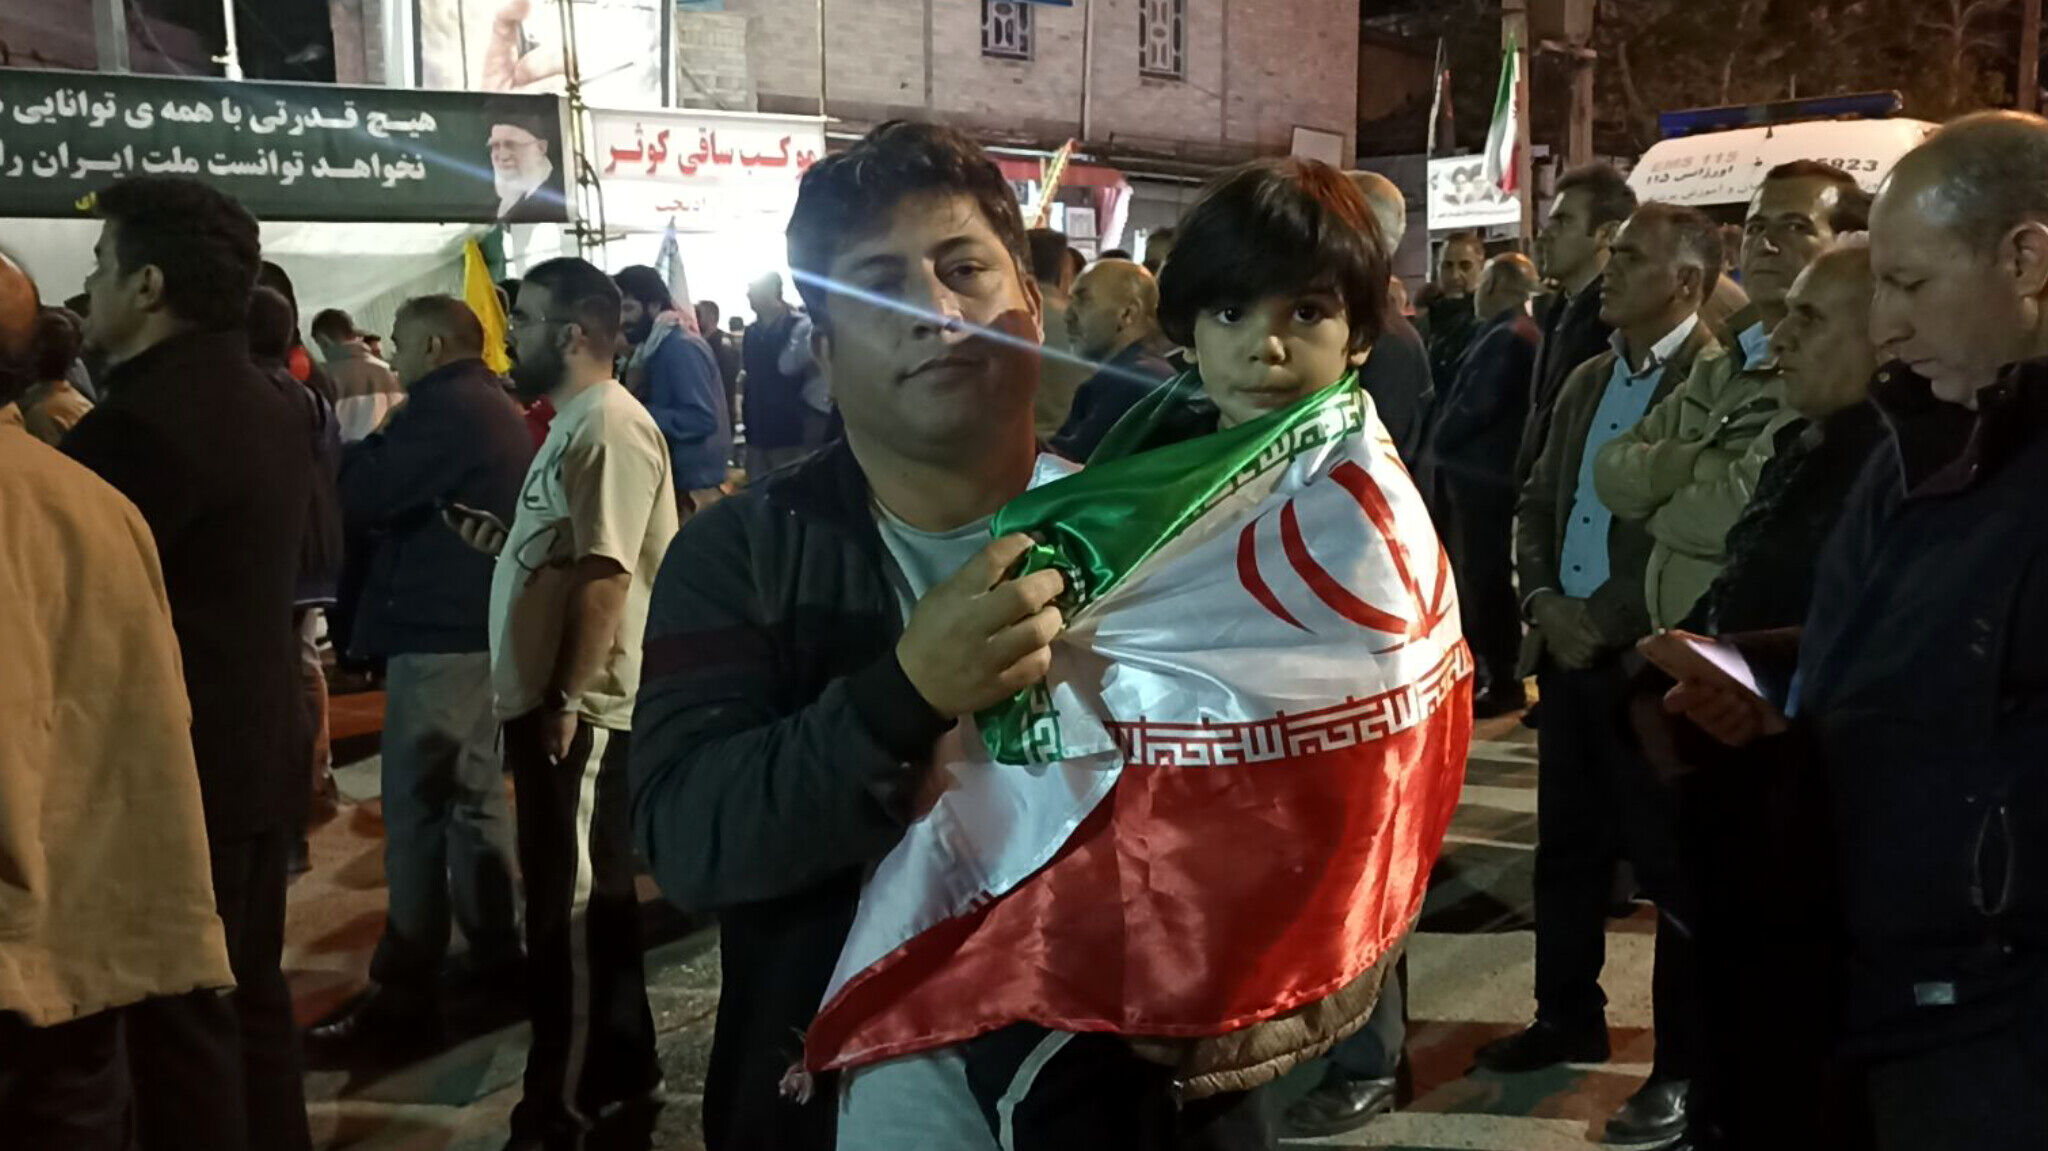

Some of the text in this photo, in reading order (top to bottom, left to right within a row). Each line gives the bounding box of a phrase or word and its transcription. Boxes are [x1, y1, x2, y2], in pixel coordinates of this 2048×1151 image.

[13, 88, 116, 127] توانایی
[160, 101, 214, 123] همه
[221, 97, 242, 132] با
[250, 100, 358, 136] قدرتی
[367, 111, 437, 138] هیچ
[32, 141, 134, 179] ایران
[142, 145, 199, 174] ملت
[604, 121, 670, 176] کوثر
[677, 127, 734, 175] ساقی
[1703, 151, 1738, 165] 115
[207, 149, 304, 186] توانست
[311, 152, 426, 187] نخواهد
